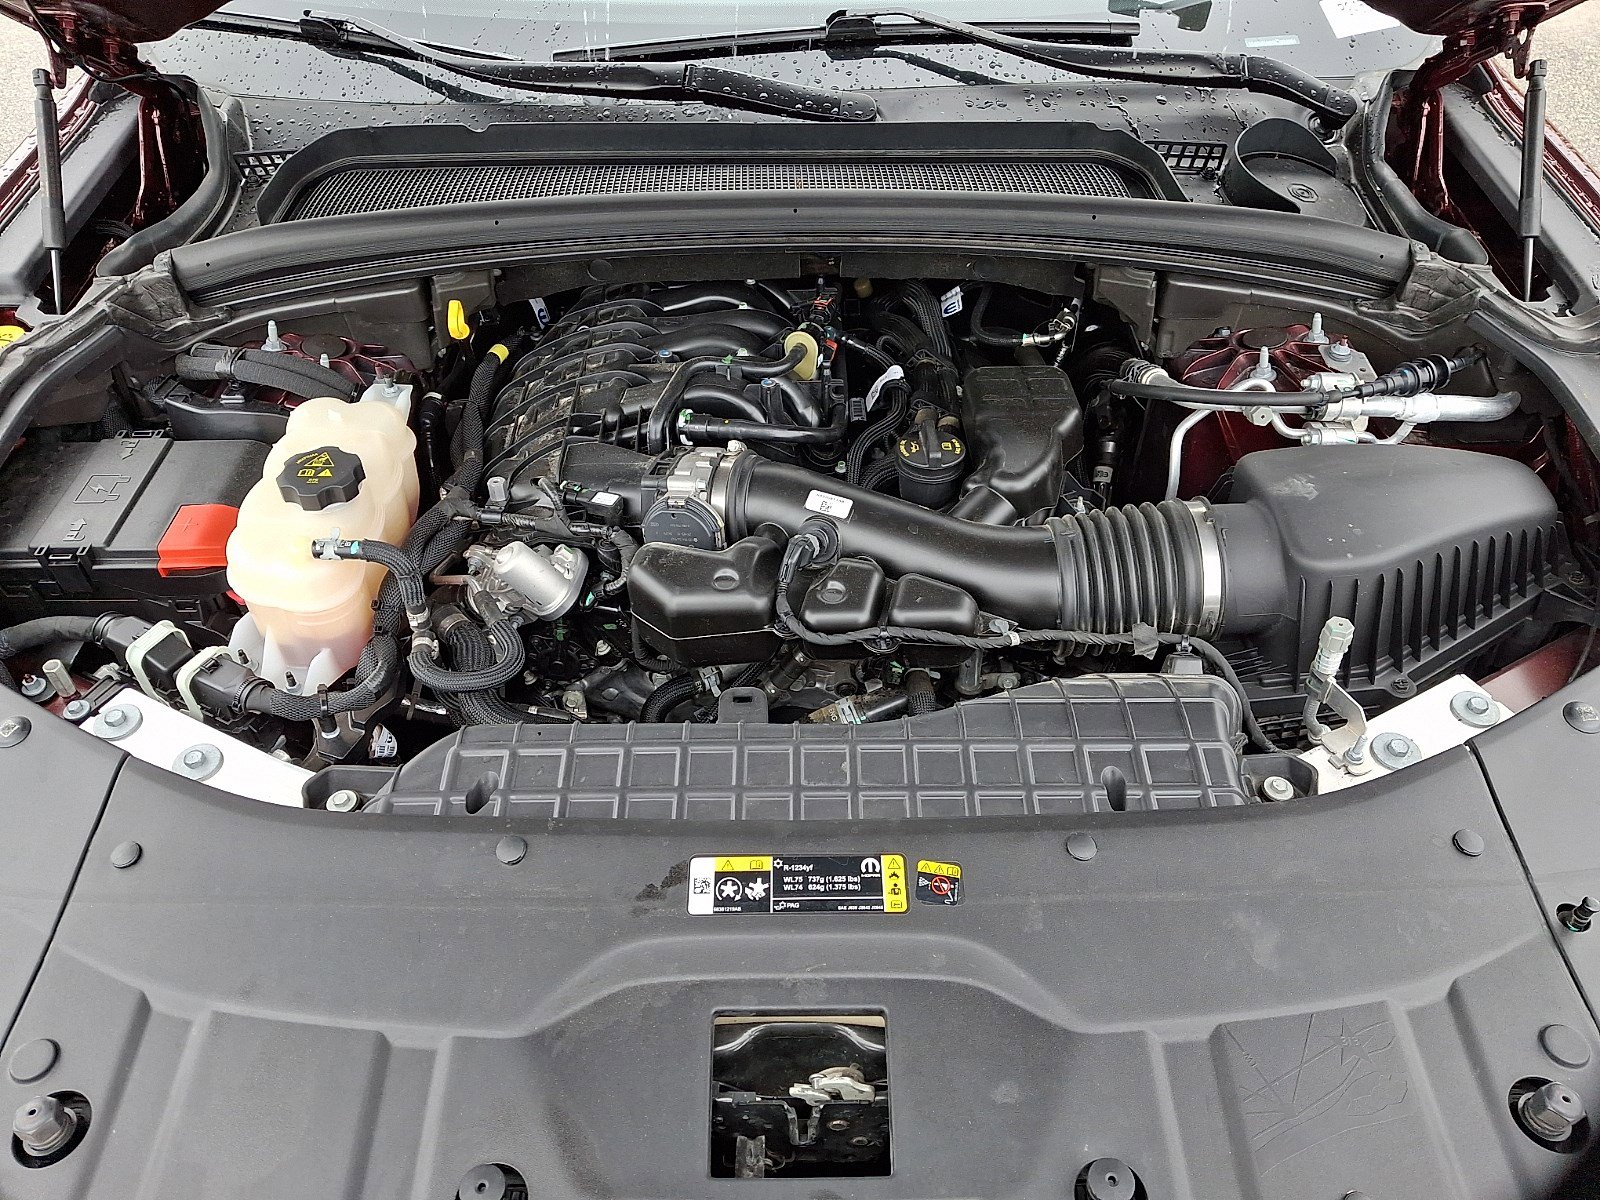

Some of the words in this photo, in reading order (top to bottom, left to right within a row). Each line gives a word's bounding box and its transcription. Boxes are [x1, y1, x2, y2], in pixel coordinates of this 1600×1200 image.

[783, 864, 814, 872] R-1234yf
[807, 876, 825, 884] 737g
[826, 875, 847, 883] (1.625
[847, 875, 861, 883] lbs)
[807, 884, 825, 892] 624g
[847, 883, 861, 891] lbs)
